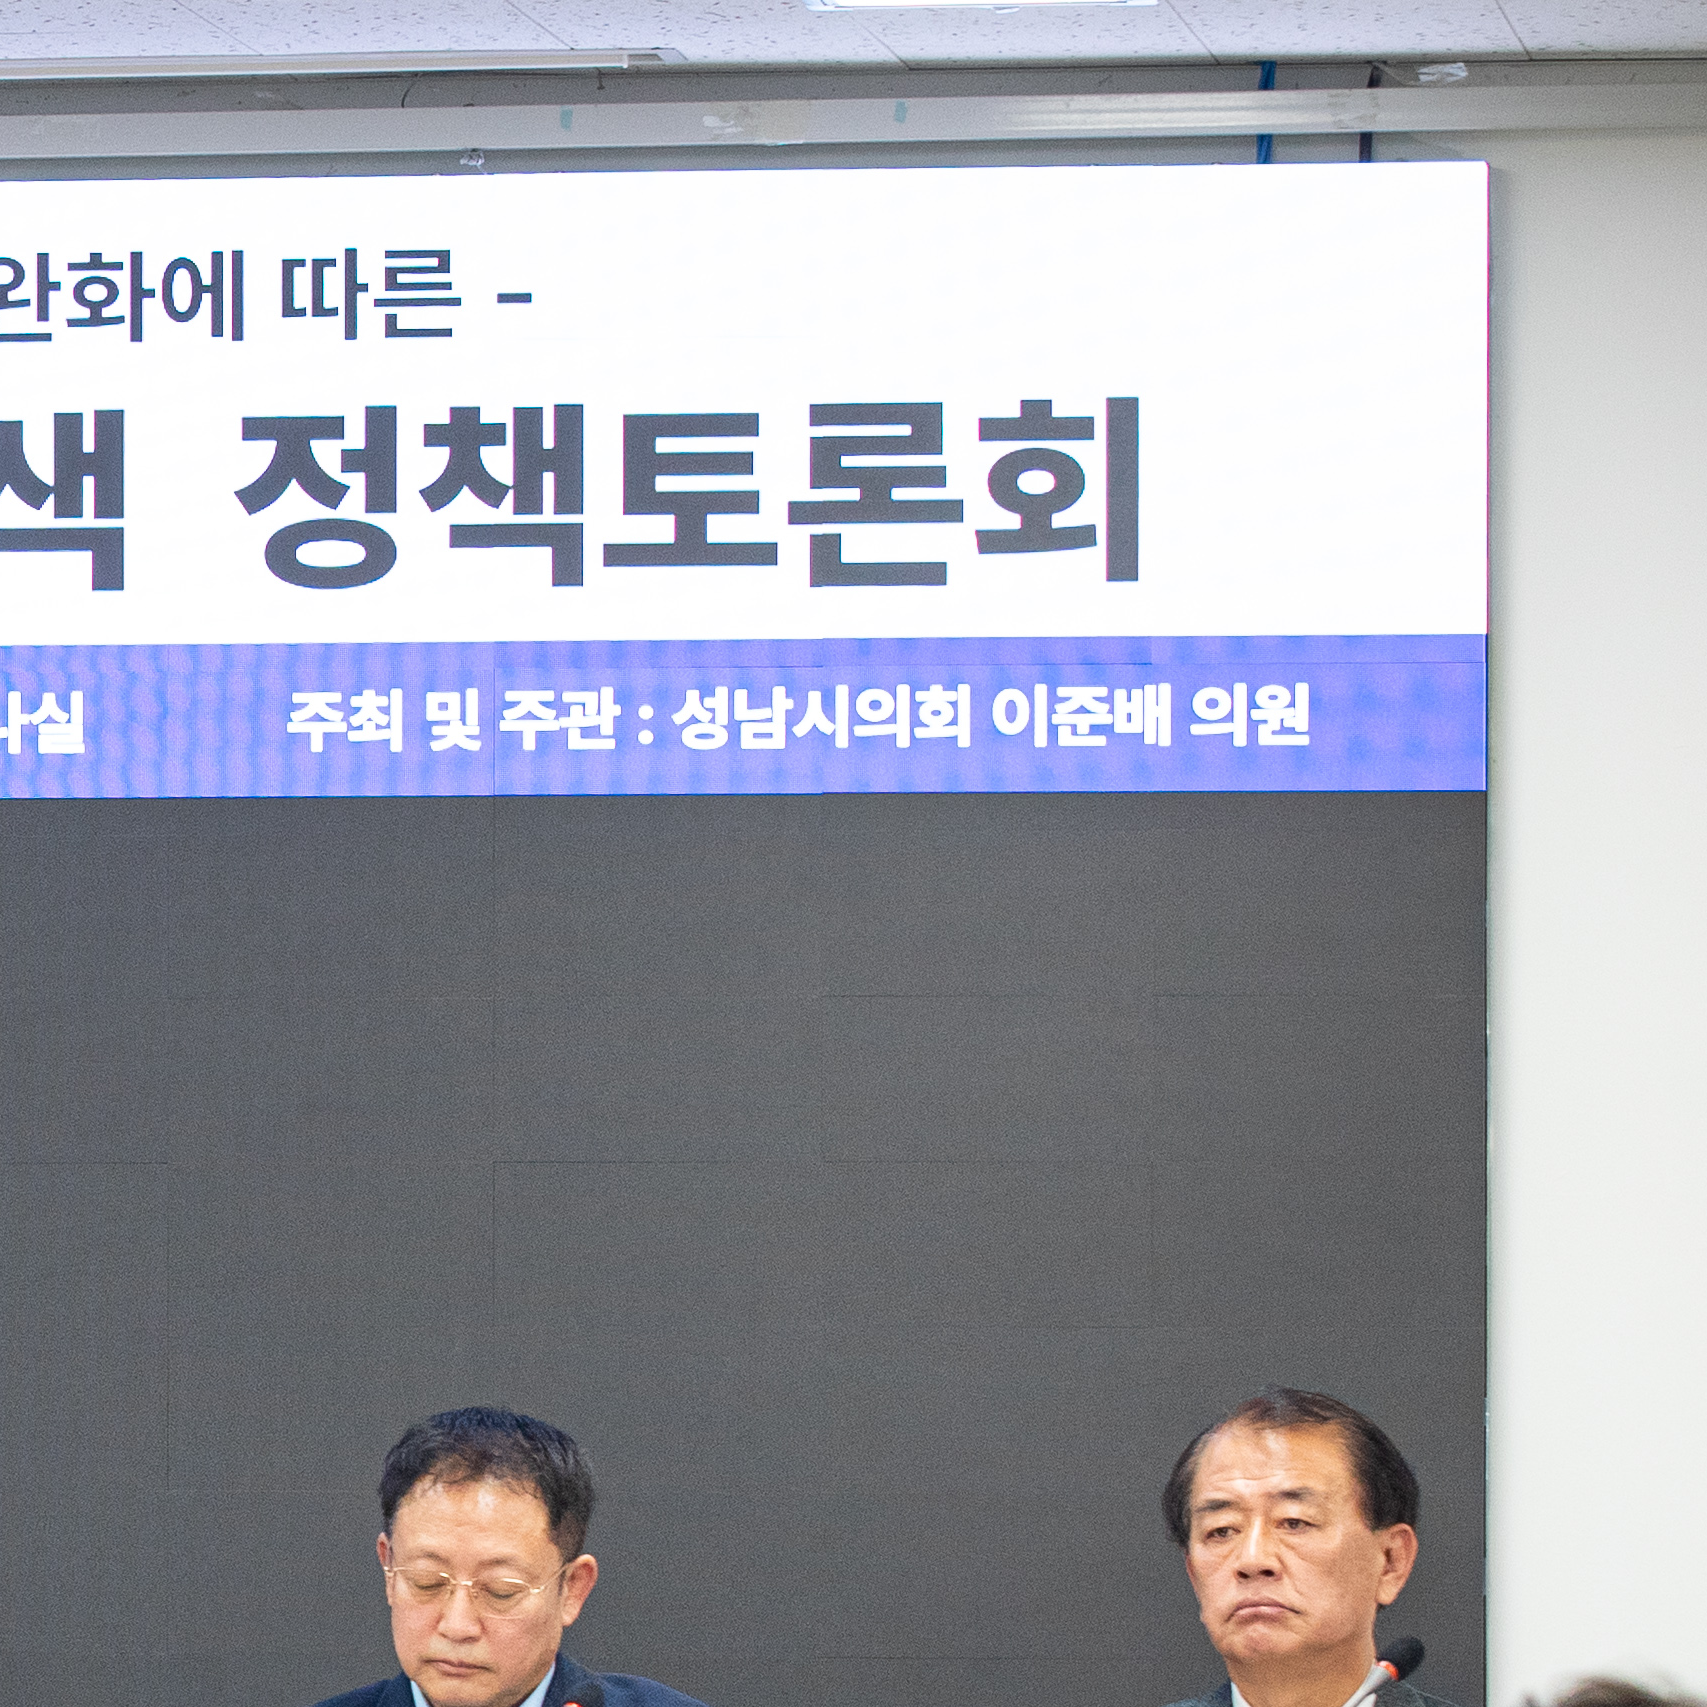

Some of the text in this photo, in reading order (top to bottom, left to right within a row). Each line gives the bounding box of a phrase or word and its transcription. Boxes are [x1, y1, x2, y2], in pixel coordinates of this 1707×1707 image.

[280, 247, 462, 341] 따른
[233, 396, 1141, 590] 정책토론회
[285, 687, 404, 753] 주최
[425, 686, 483, 752] 및
[498, 685, 623, 751] 주관
[671, 682, 972, 750] 성남시의회
[991, 681, 1173, 748] 이준배
[1188, 681, 1311, 747] 의원
